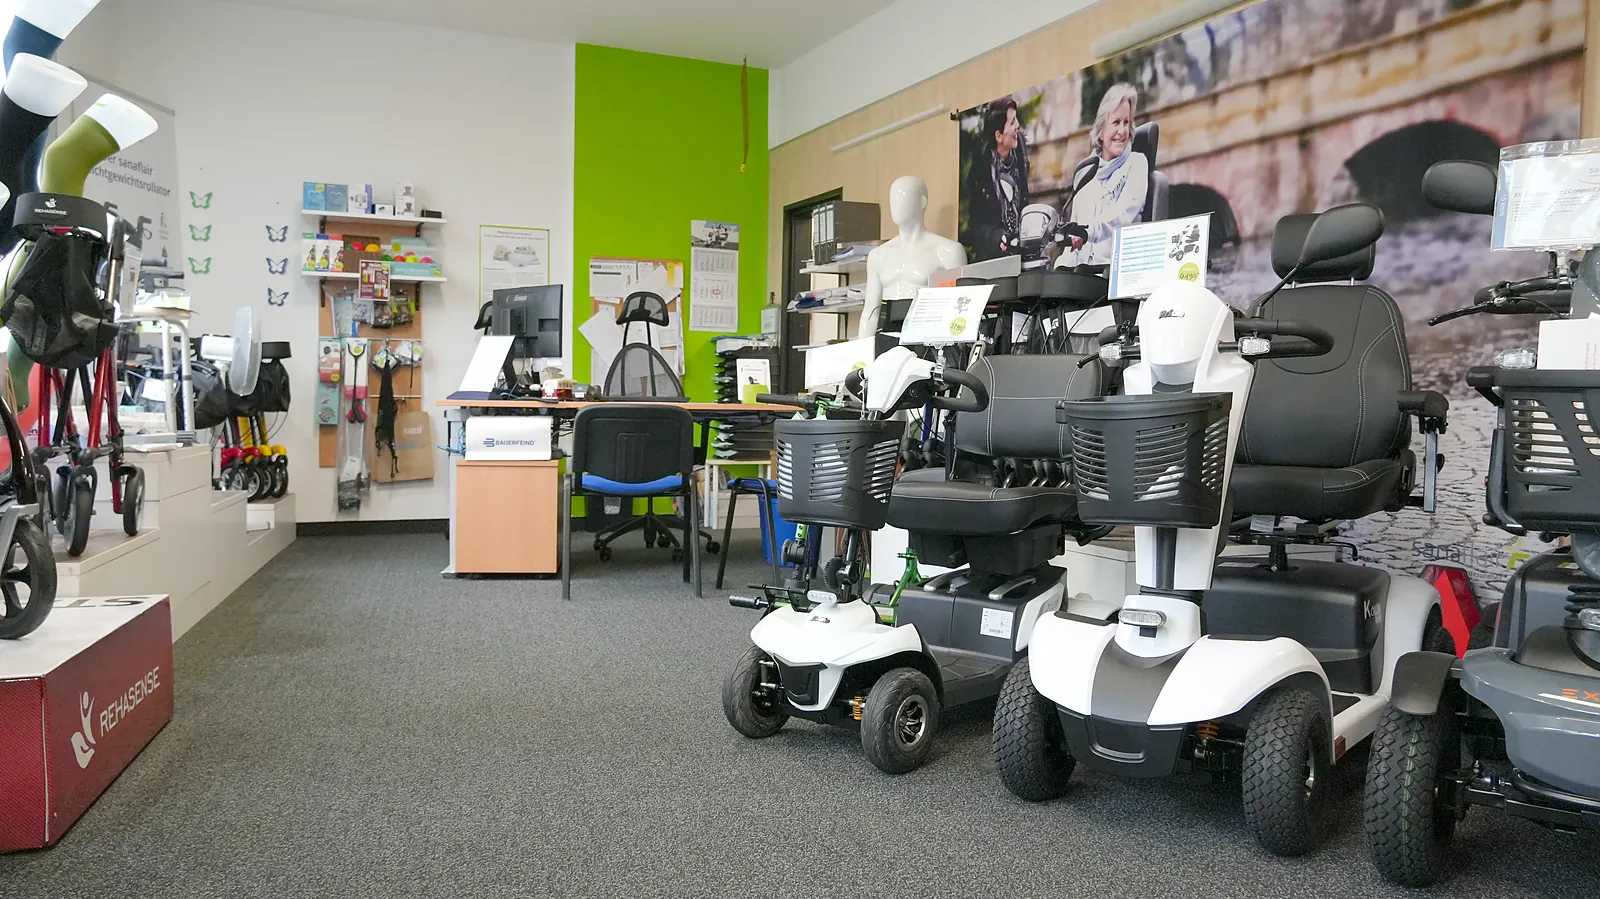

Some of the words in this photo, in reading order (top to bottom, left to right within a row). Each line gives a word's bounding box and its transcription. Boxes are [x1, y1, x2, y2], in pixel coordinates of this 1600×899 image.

[118, 157, 154, 176] sanaflair
[89, 165, 171, 197] ichtgewichtsrollator
[34, 208, 68, 216] REHASENSE
[99, 665, 161, 738] REHASENSE
